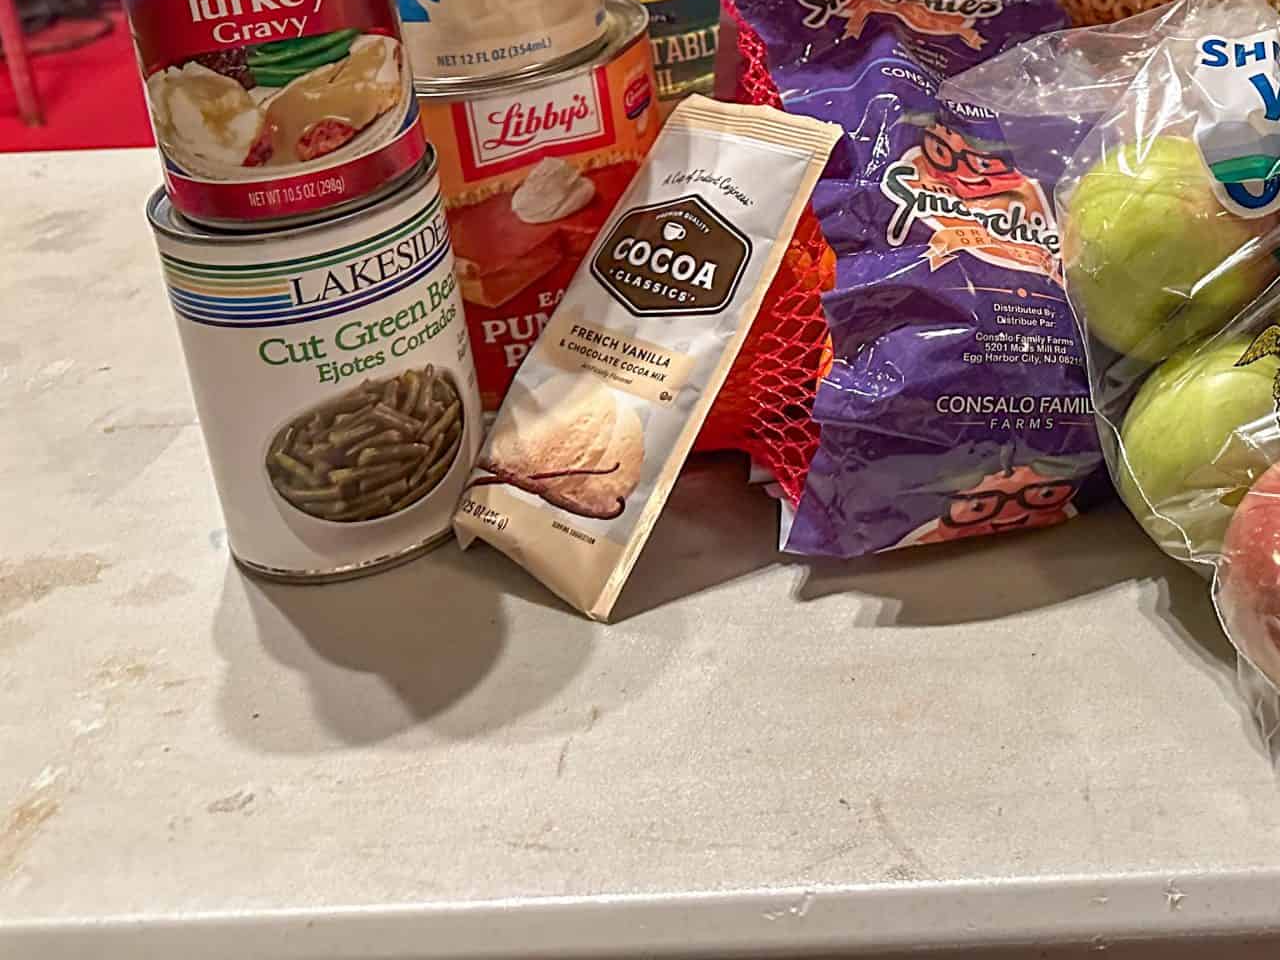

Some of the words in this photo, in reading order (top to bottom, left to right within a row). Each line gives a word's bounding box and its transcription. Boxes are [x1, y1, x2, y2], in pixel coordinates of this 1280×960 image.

[212, 15, 308, 43] Gravy
[492, 47, 506, 61] OZ
[483, 94, 590, 150] Libby's
[248, 191, 265, 207] NET
[266, 189, 281, 205] WT
[283, 188, 302, 203] 10.5
[304, 183, 317, 198] OZ
[289, 216, 445, 307] LAKESIDE
[612, 237, 717, 291] COCOA
[615, 270, 688, 302] CLASSICS
[993, 303, 1042, 315] Distributed
[259, 338, 326, 366] Cut
[335, 300, 427, 352] Green
[316, 350, 386, 384] Ejotes
[391, 304, 457, 357] Cortados
[975, 332, 1014, 342] Consalo
[1015, 334, 1045, 344] Family
[1047, 336, 1074, 346] Farms
[503, 344, 531, 368] P
[570, 325, 620, 351] FRENCH
[622, 343, 671, 368] VANILLA
[963, 353, 983, 363] Egg
[985, 353, 1019, 362] Harbor
[1044, 355, 1057, 364] NJ
[985, 343, 1008, 352] 5201
[1037, 345, 1053, 353] Mill
[1054, 346, 1067, 354] Rd
[567, 342, 620, 367] CHOCOLATE
[620, 361, 649, 377] COCOA
[650, 372, 667, 382] MIX
[935, 396, 1035, 414] CONSALO
[990, 418, 1054, 430] FARMS
